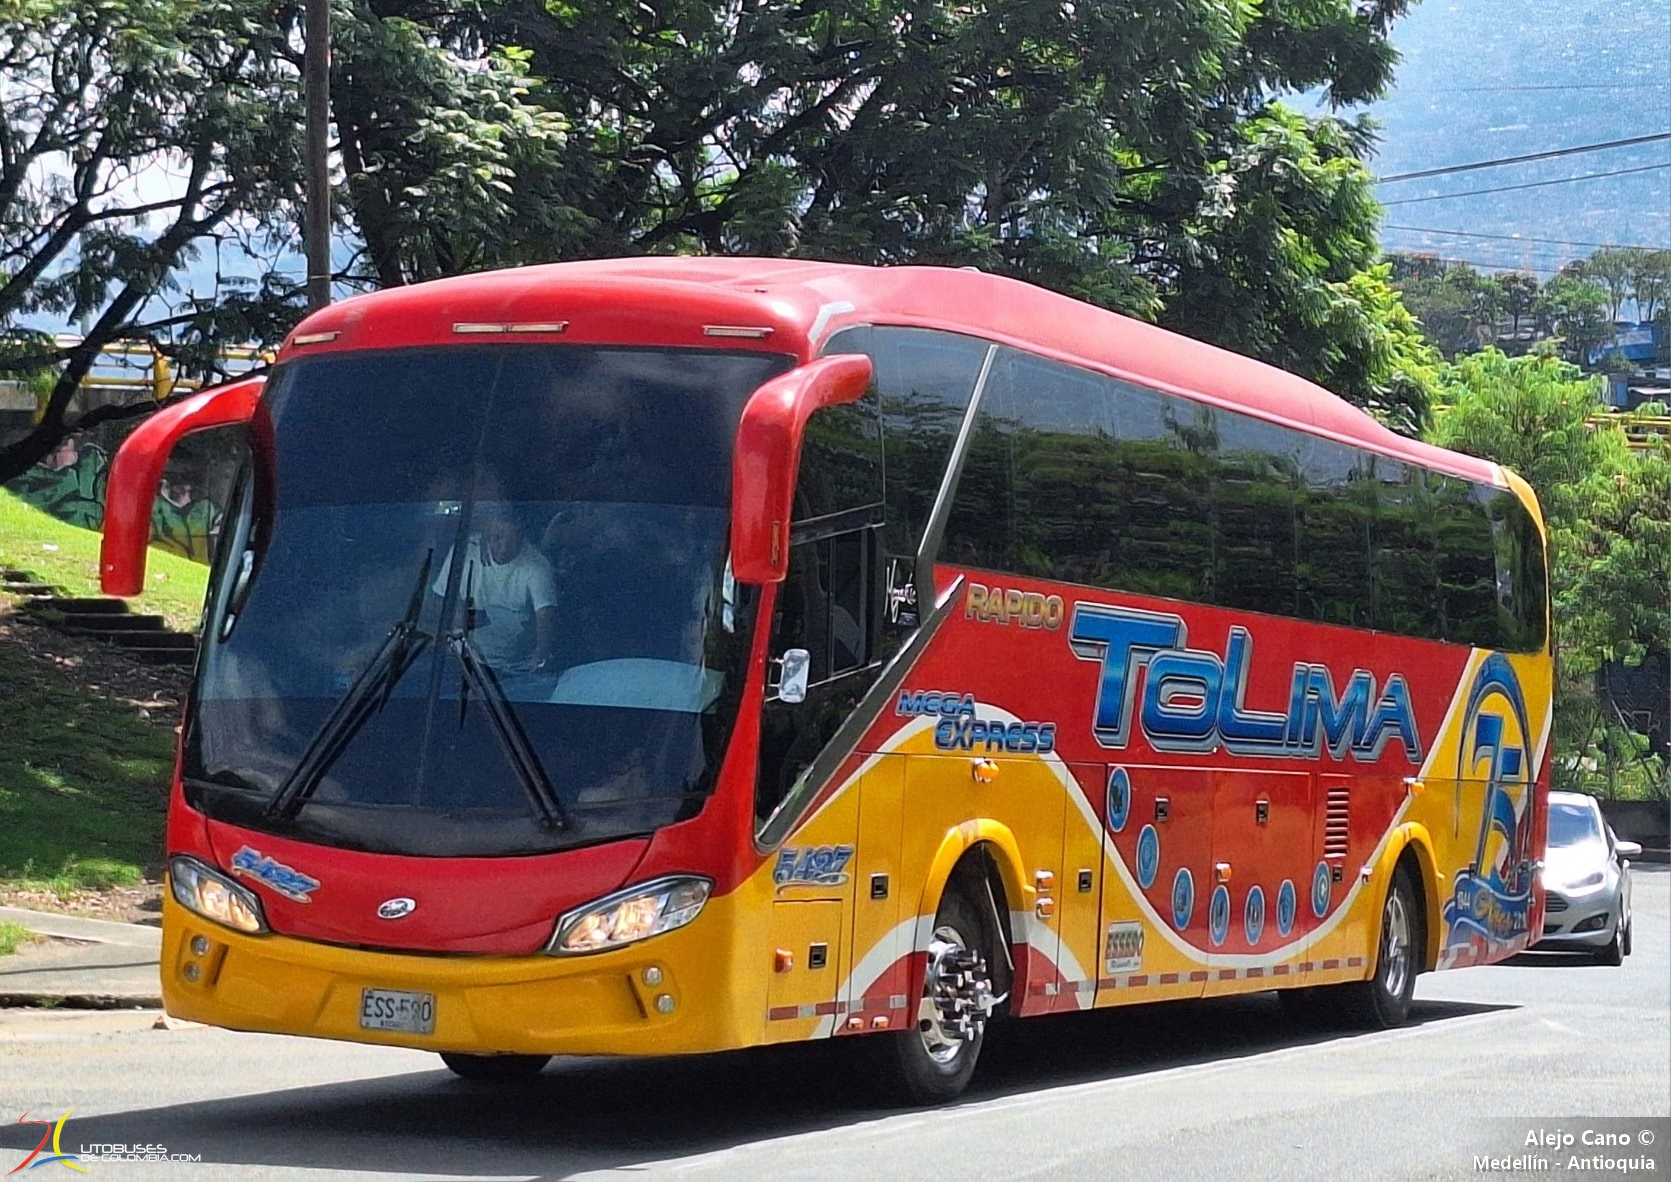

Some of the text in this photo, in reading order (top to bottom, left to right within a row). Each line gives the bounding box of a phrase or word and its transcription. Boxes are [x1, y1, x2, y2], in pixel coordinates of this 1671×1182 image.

[965, 583, 1064, 630] RAPIDO
[895, 688, 976, 719] MEGA
[934, 718, 1056, 754] EXPRESS
